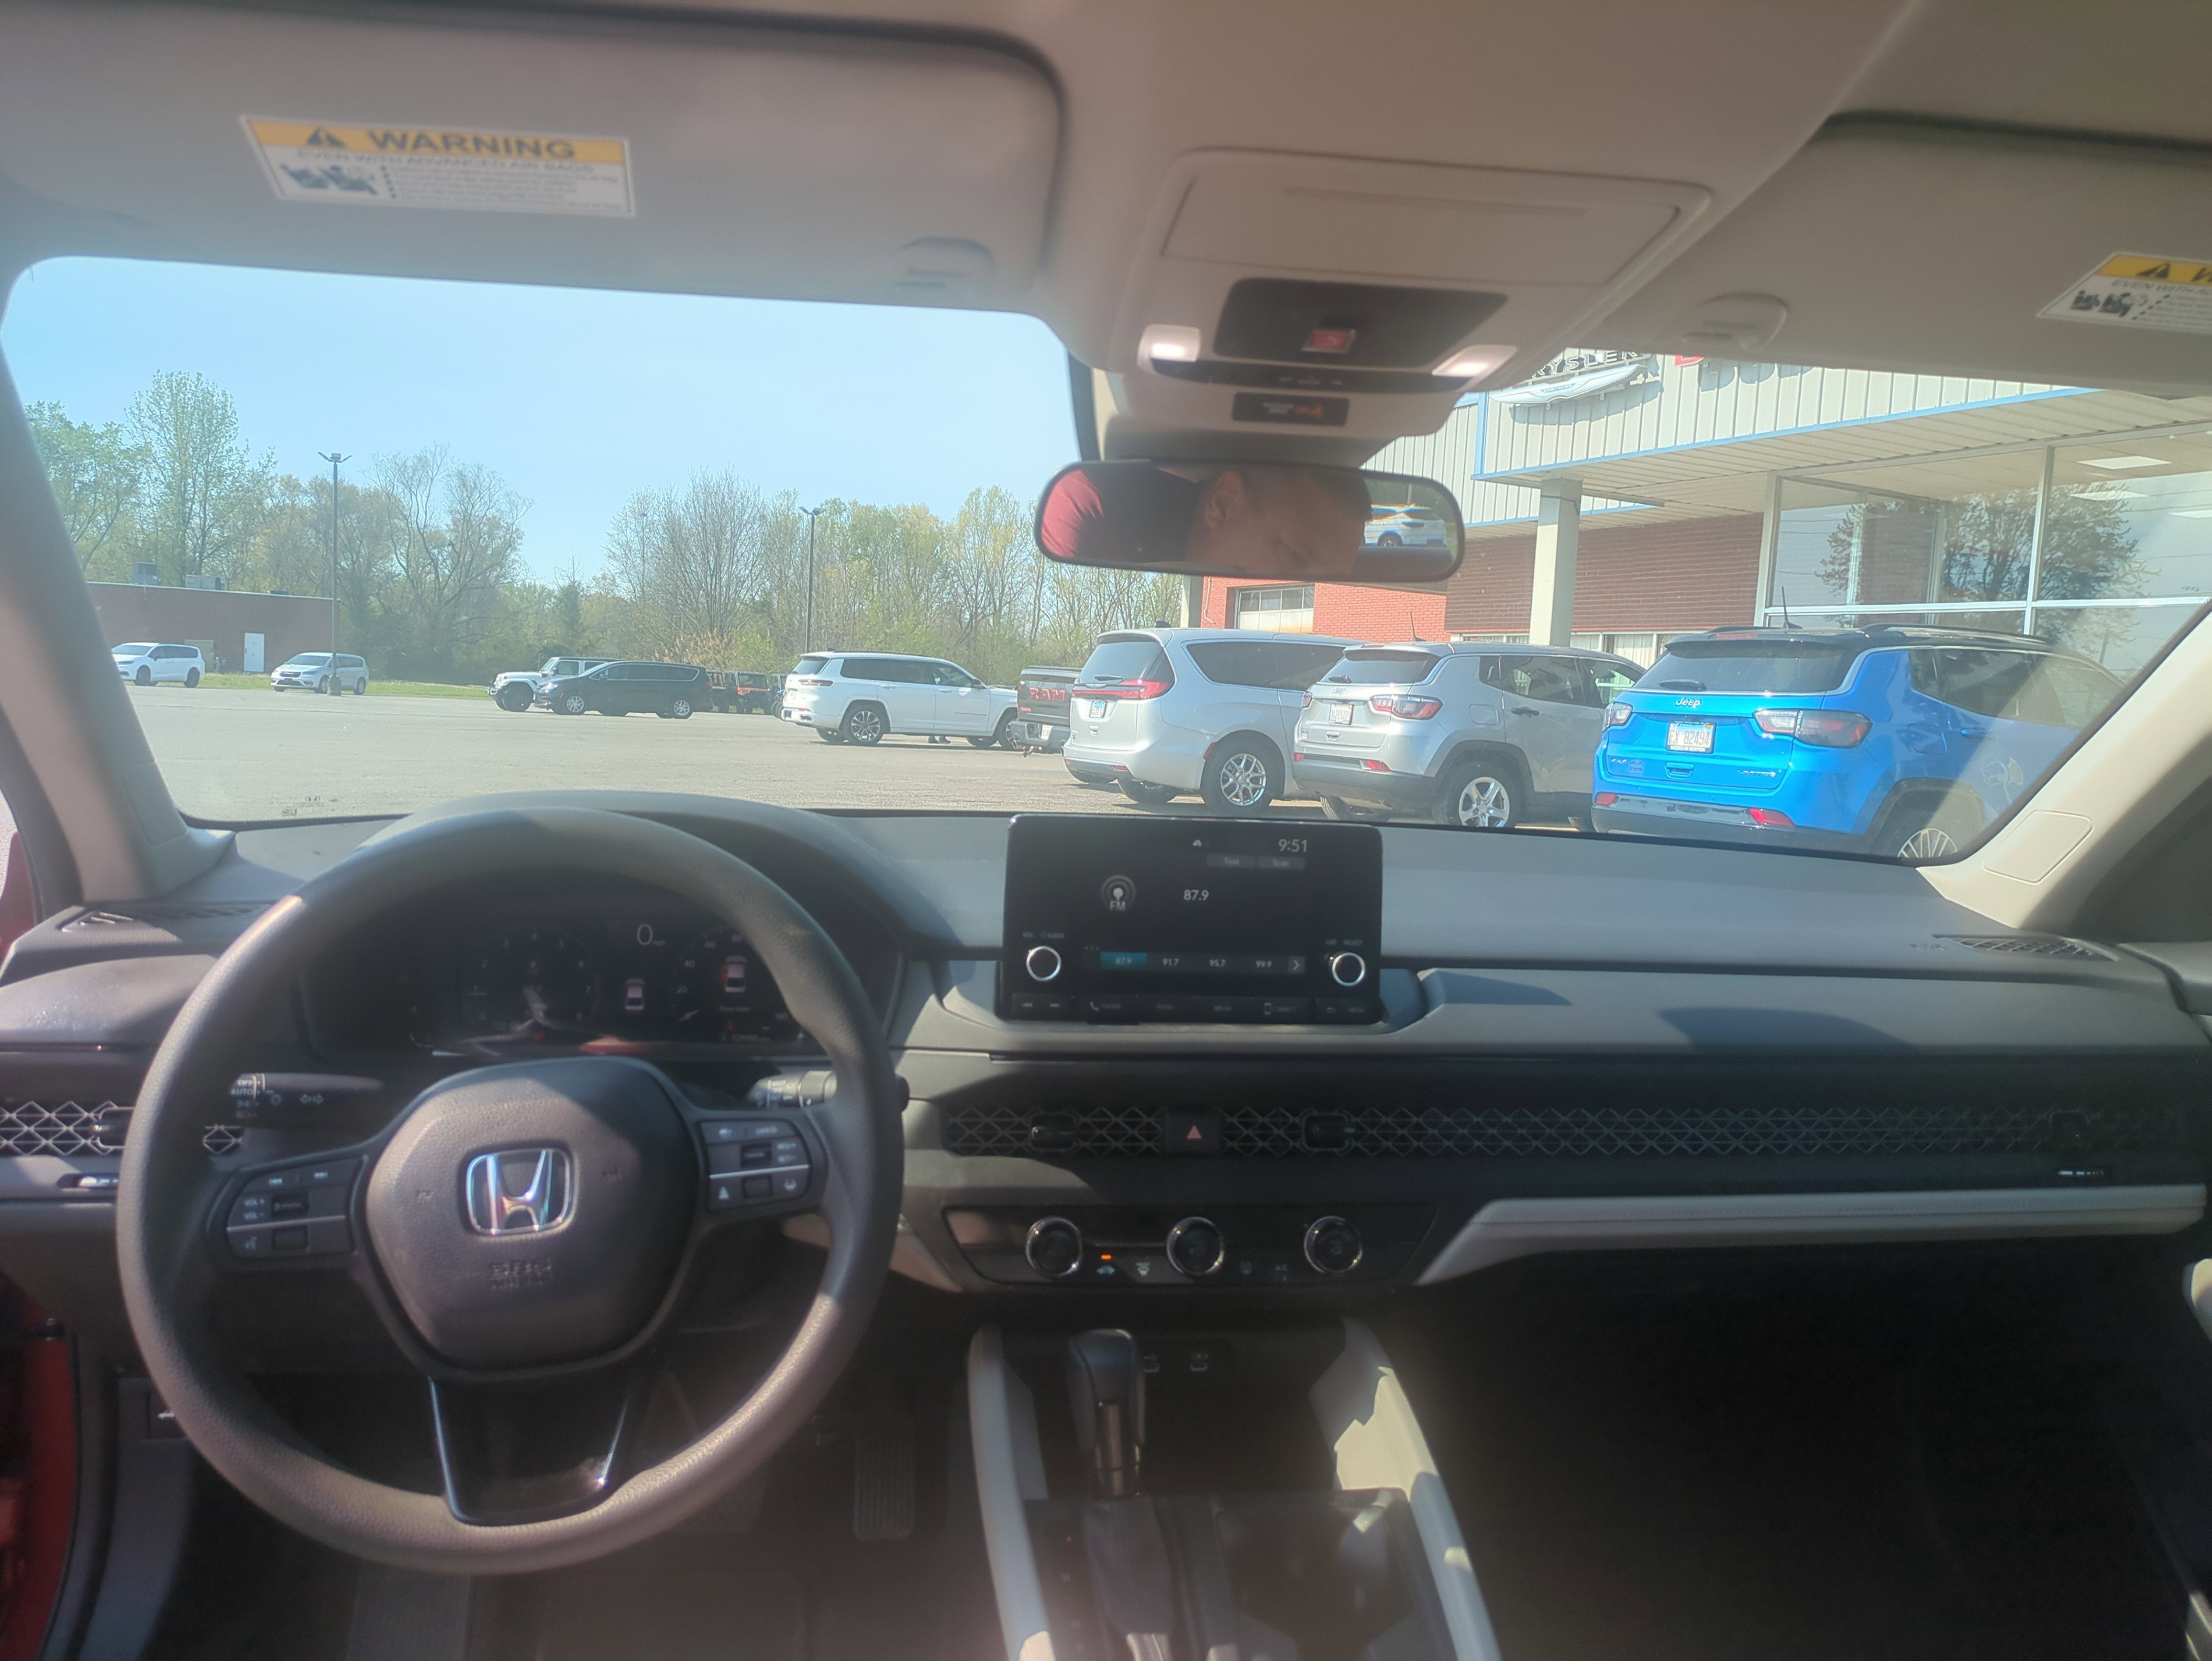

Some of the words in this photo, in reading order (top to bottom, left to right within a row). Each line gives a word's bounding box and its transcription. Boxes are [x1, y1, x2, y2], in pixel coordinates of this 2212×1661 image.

[368, 131, 575, 158] WARNING
[1029, 687, 1066, 701] RAM
[1676, 697, 1702, 708] Jeep
[1669, 730, 1679, 743] FX
[1684, 730, 1710, 745] 82494
[1278, 839, 1307, 852] 9:51
[1183, 889, 1209, 901] 87.9
[1109, 900, 1126, 911] FM
[637, 924, 653, 946] 0
[684, 959, 696, 968] 40
[676, 986, 688, 995] 20
